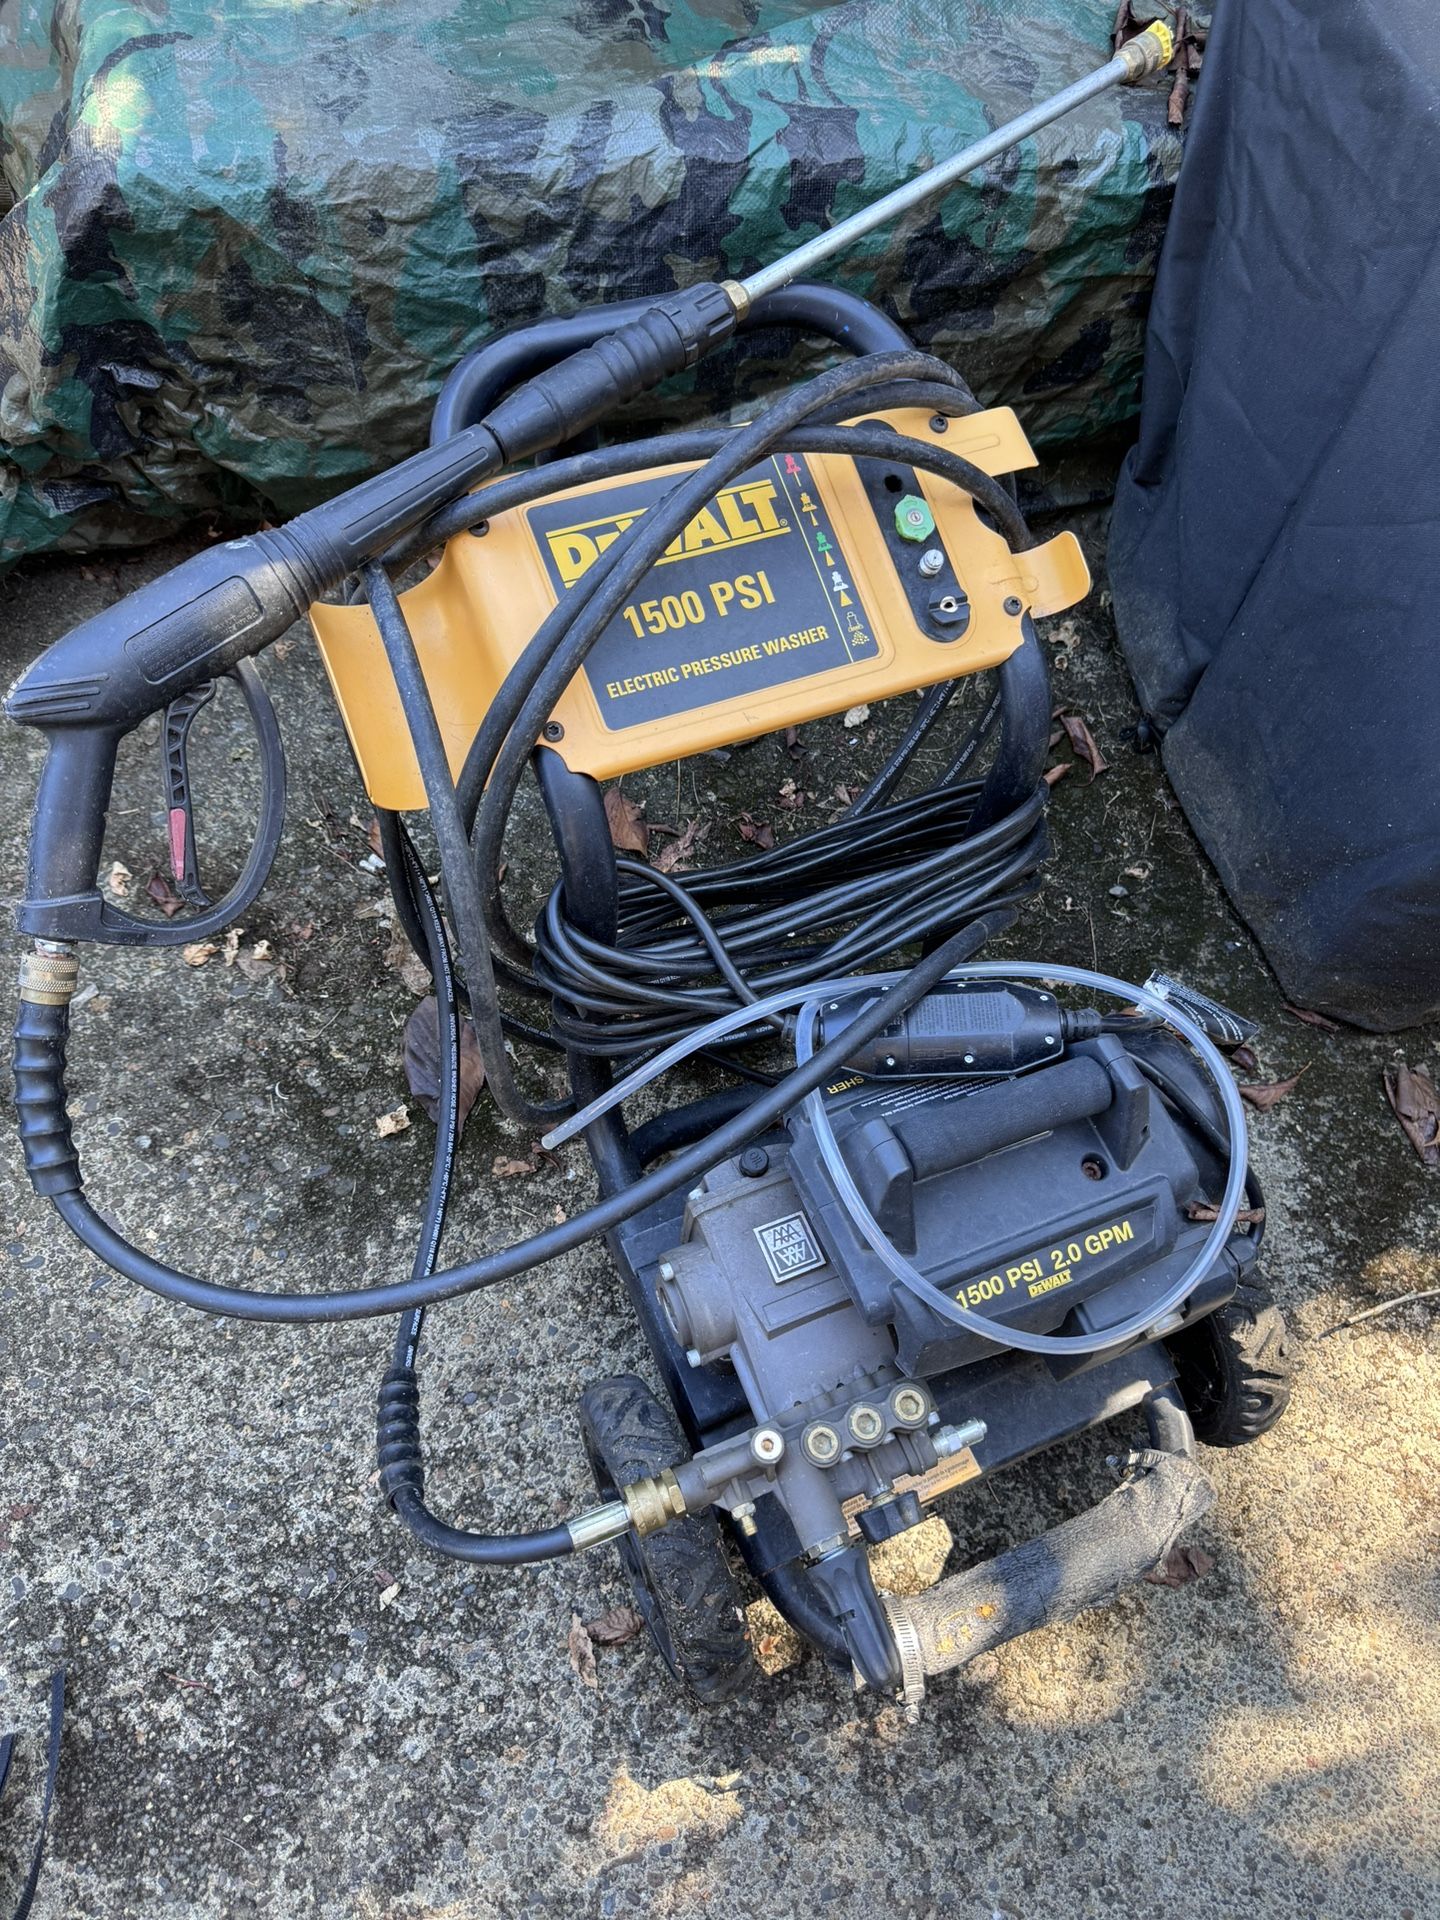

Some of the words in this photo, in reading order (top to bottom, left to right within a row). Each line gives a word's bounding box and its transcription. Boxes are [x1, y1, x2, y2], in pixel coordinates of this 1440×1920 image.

[623, 590, 706, 638] 1500
[709, 571, 776, 617] PSI
[606, 667, 680, 698] ELECTRIC
[680, 644, 762, 679] PRESSURE
[762, 625, 829, 656] WASHER
[449, 1013, 457, 1041] UNIVERSAL
[955, 1275, 1005, 1310] 1500
[1006, 1258, 1044, 1289] PSI
[1050, 1243, 1082, 1271] 2.0
[1084, 1220, 1135, 1256] GPM
